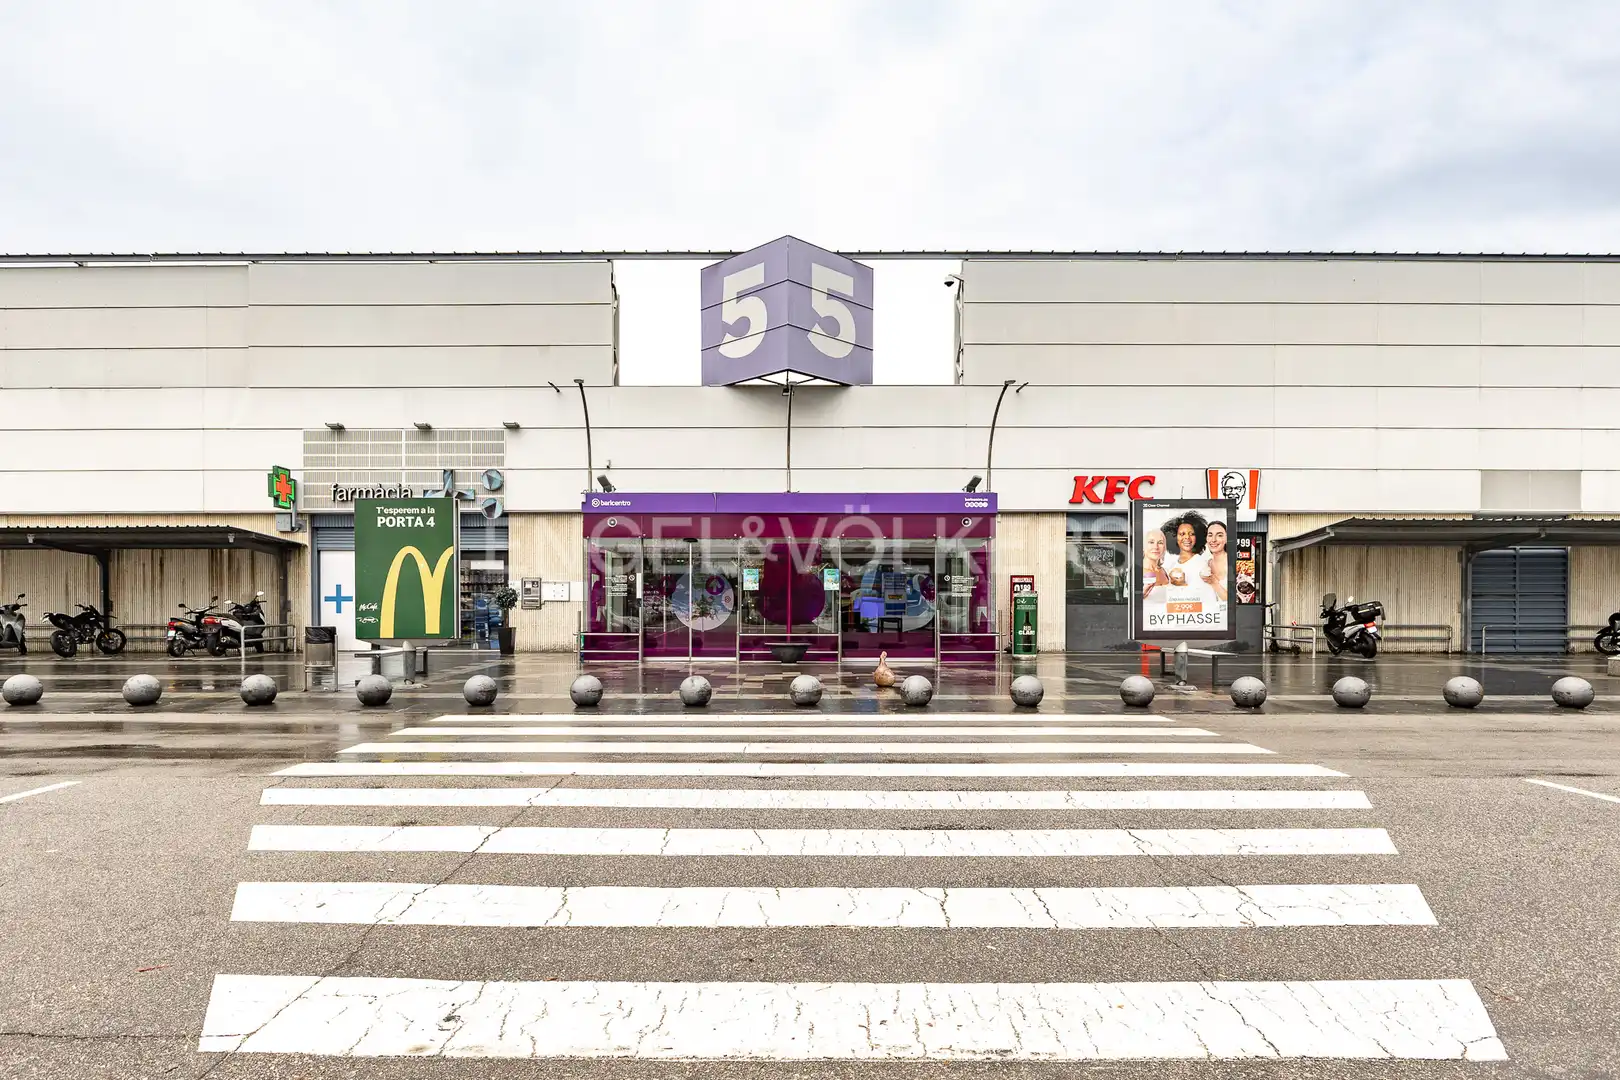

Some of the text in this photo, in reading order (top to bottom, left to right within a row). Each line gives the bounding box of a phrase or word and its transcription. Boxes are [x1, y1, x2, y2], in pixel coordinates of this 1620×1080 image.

[718, 262, 768, 359] 5
[807, 262, 856, 359] 5
[331, 483, 413, 502] farmàcia
[1069, 475, 1156, 504] KFC
[376, 506, 419, 515] T'esperem
[427, 506, 435, 514] la
[377, 516, 436, 528] PORTA 4
[1149, 613, 1221, 626] BYPHASSE
